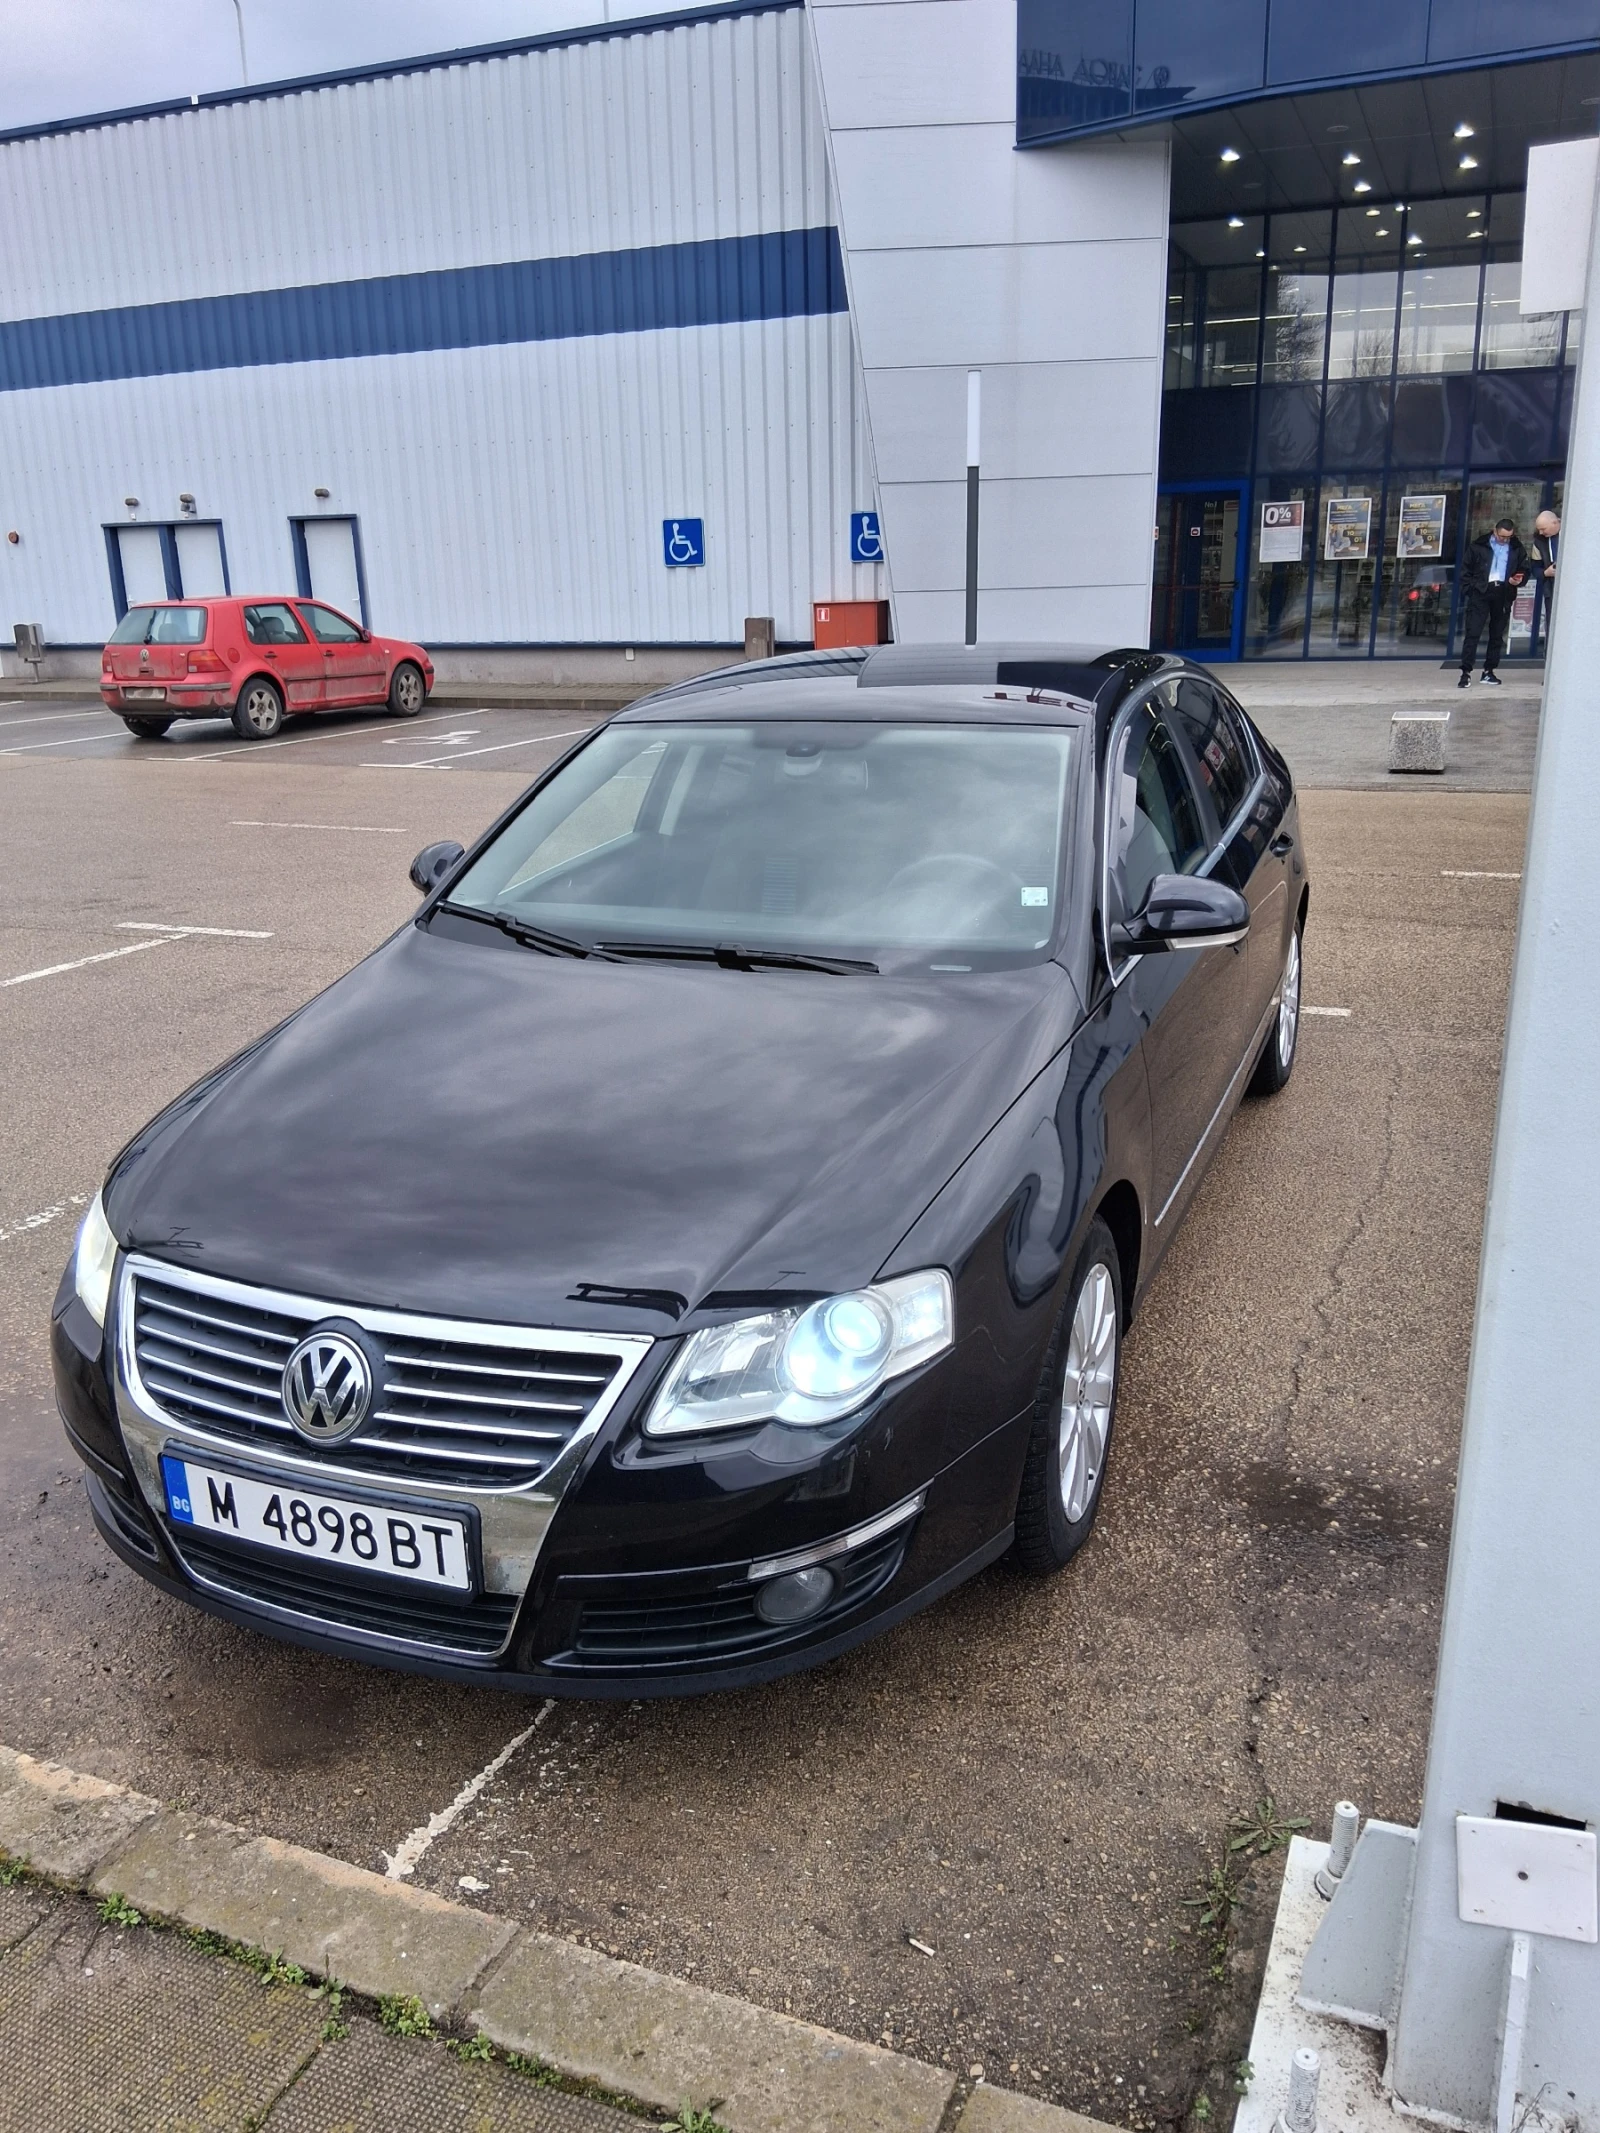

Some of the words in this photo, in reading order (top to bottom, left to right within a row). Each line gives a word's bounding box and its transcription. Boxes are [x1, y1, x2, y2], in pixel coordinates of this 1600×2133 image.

[1265, 507, 1292, 525] 0%
[172, 1495, 190, 1513] BG
[206, 1476, 240, 1529] M
